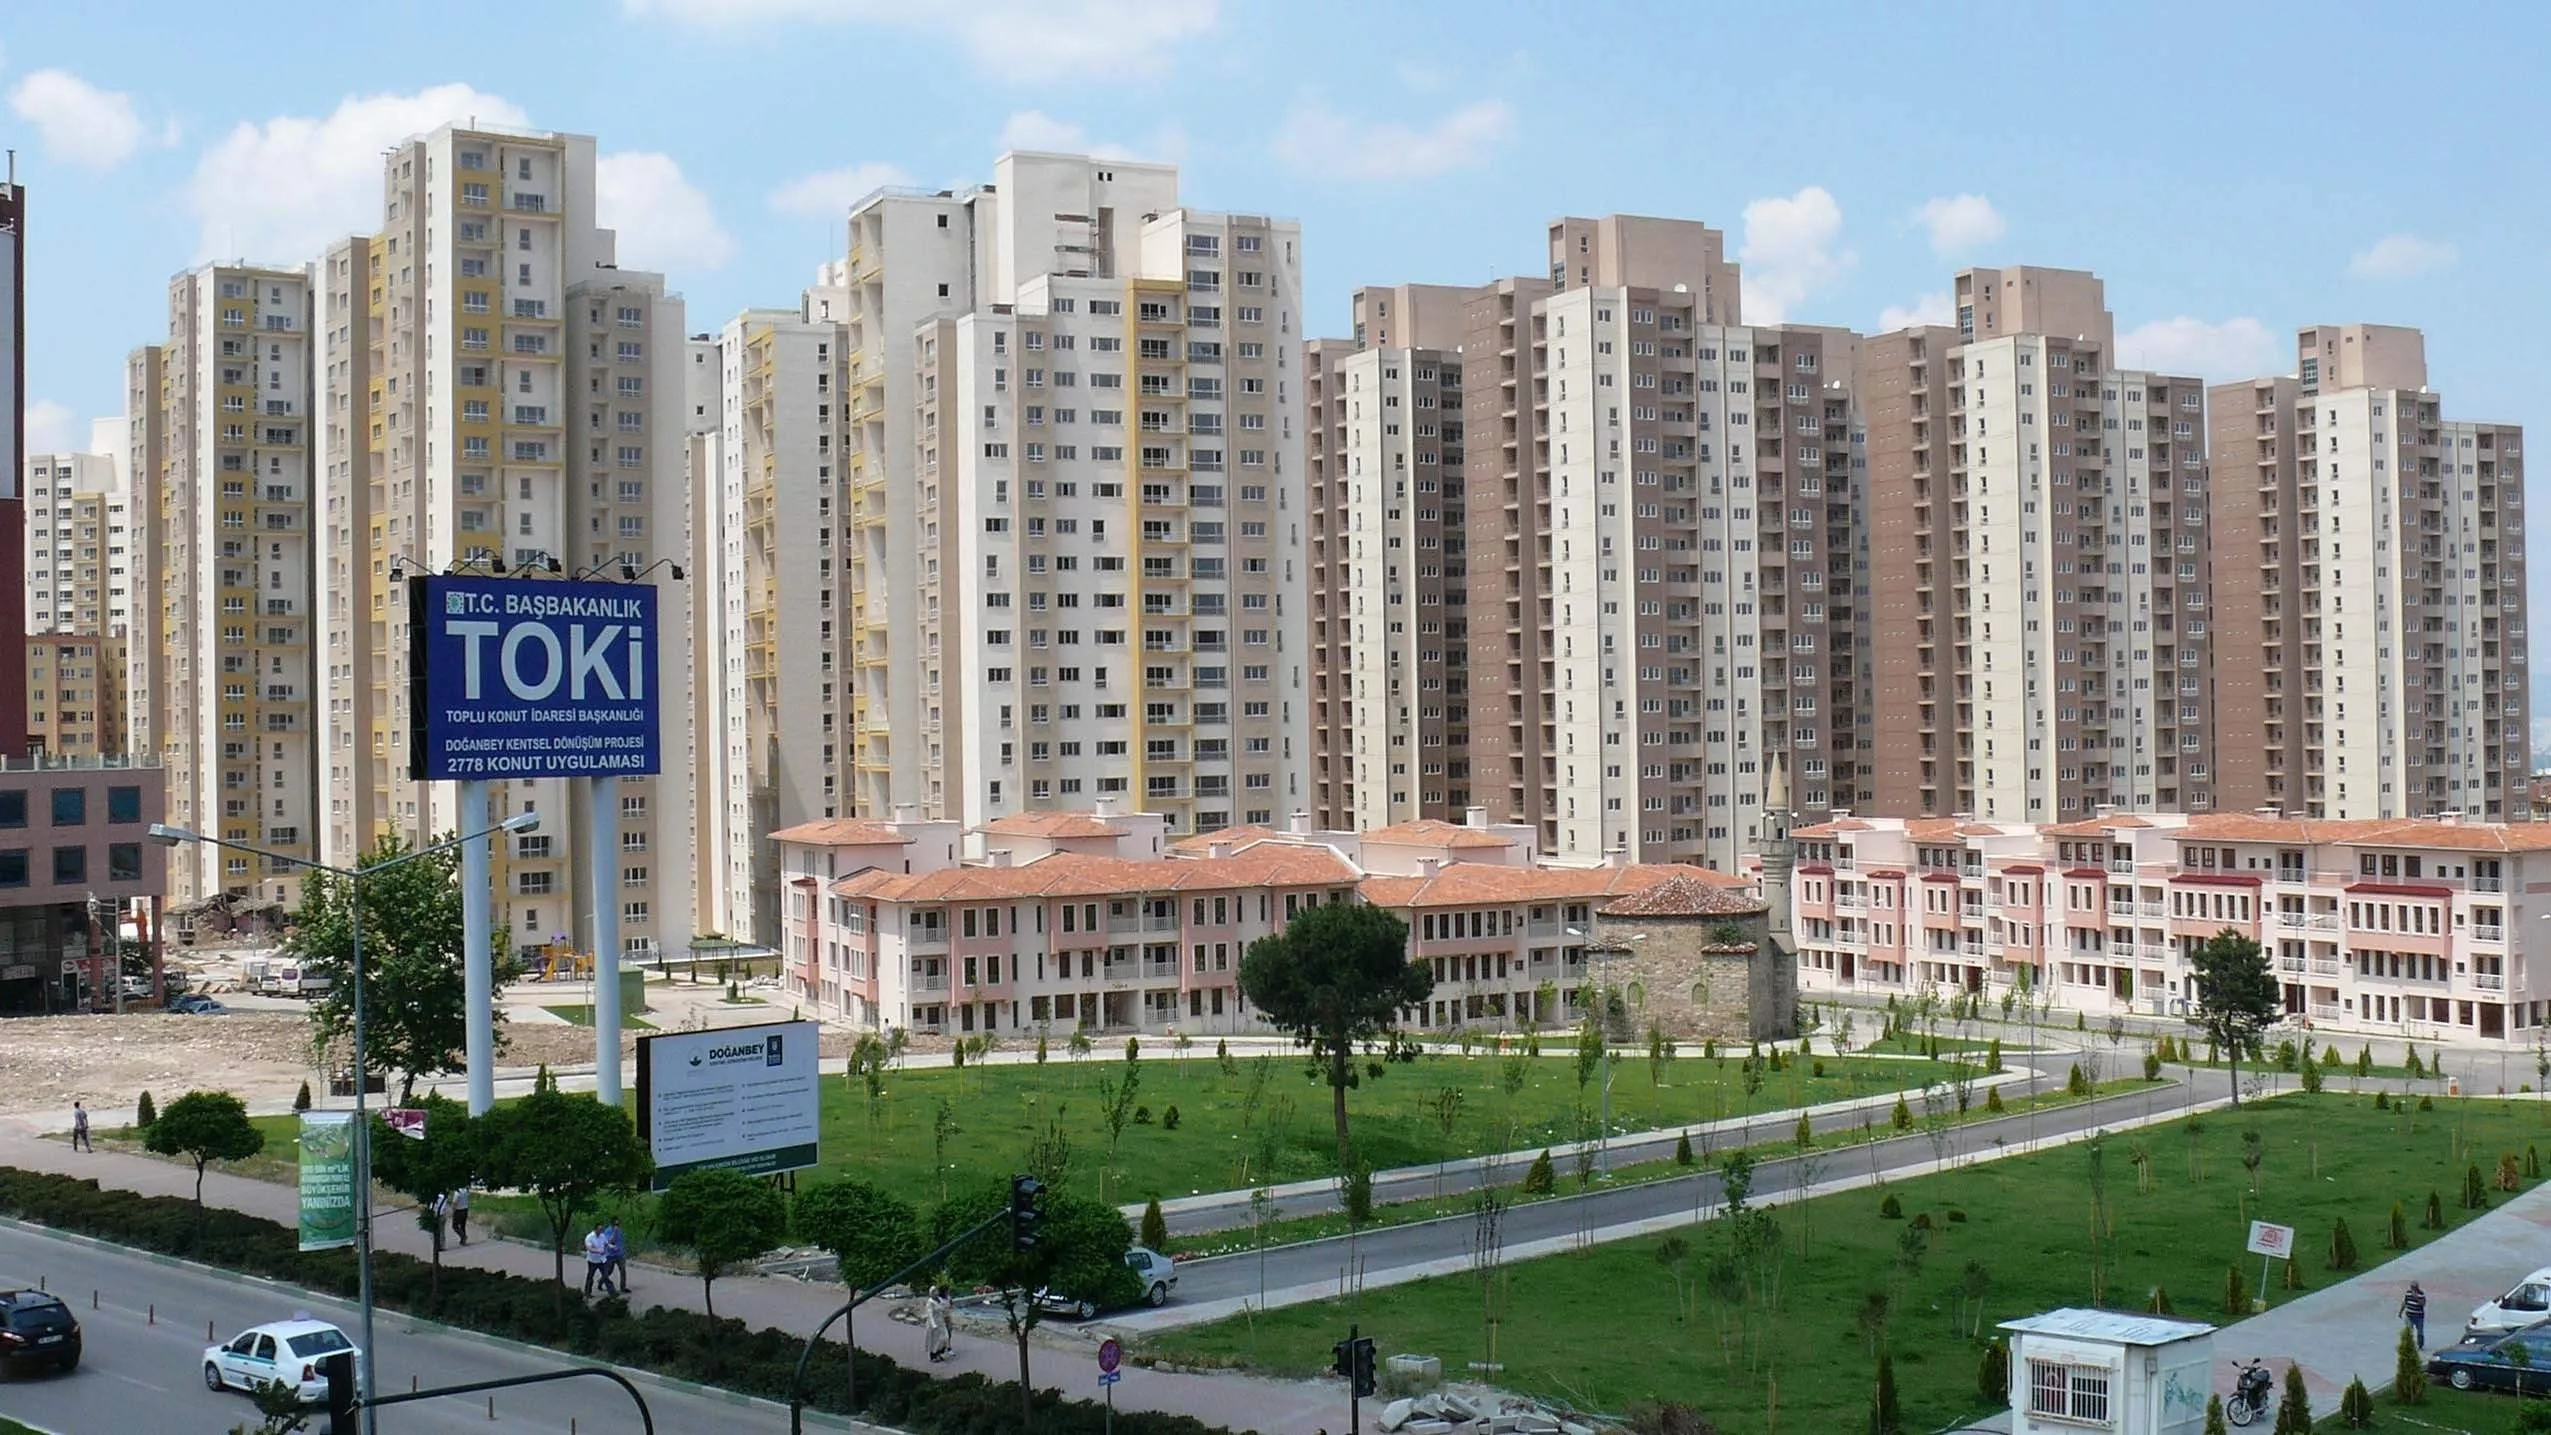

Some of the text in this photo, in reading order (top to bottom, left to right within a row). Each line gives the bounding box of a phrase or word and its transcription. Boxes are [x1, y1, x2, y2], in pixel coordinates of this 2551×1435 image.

[465, 593, 641, 619] T.C. BAŞBAKANLIK
[446, 708, 643, 724] TOPLU KONUT İDARESİ BAŞKANLIĞI
[446, 736, 644, 752] DOĞANBEY KENTSEL DÖNÜŞÜM PROJESİ
[448, 756, 644, 772] 2778 KONUT UYGULAMASI
[709, 1044, 764, 1059] DOĞANBEY
